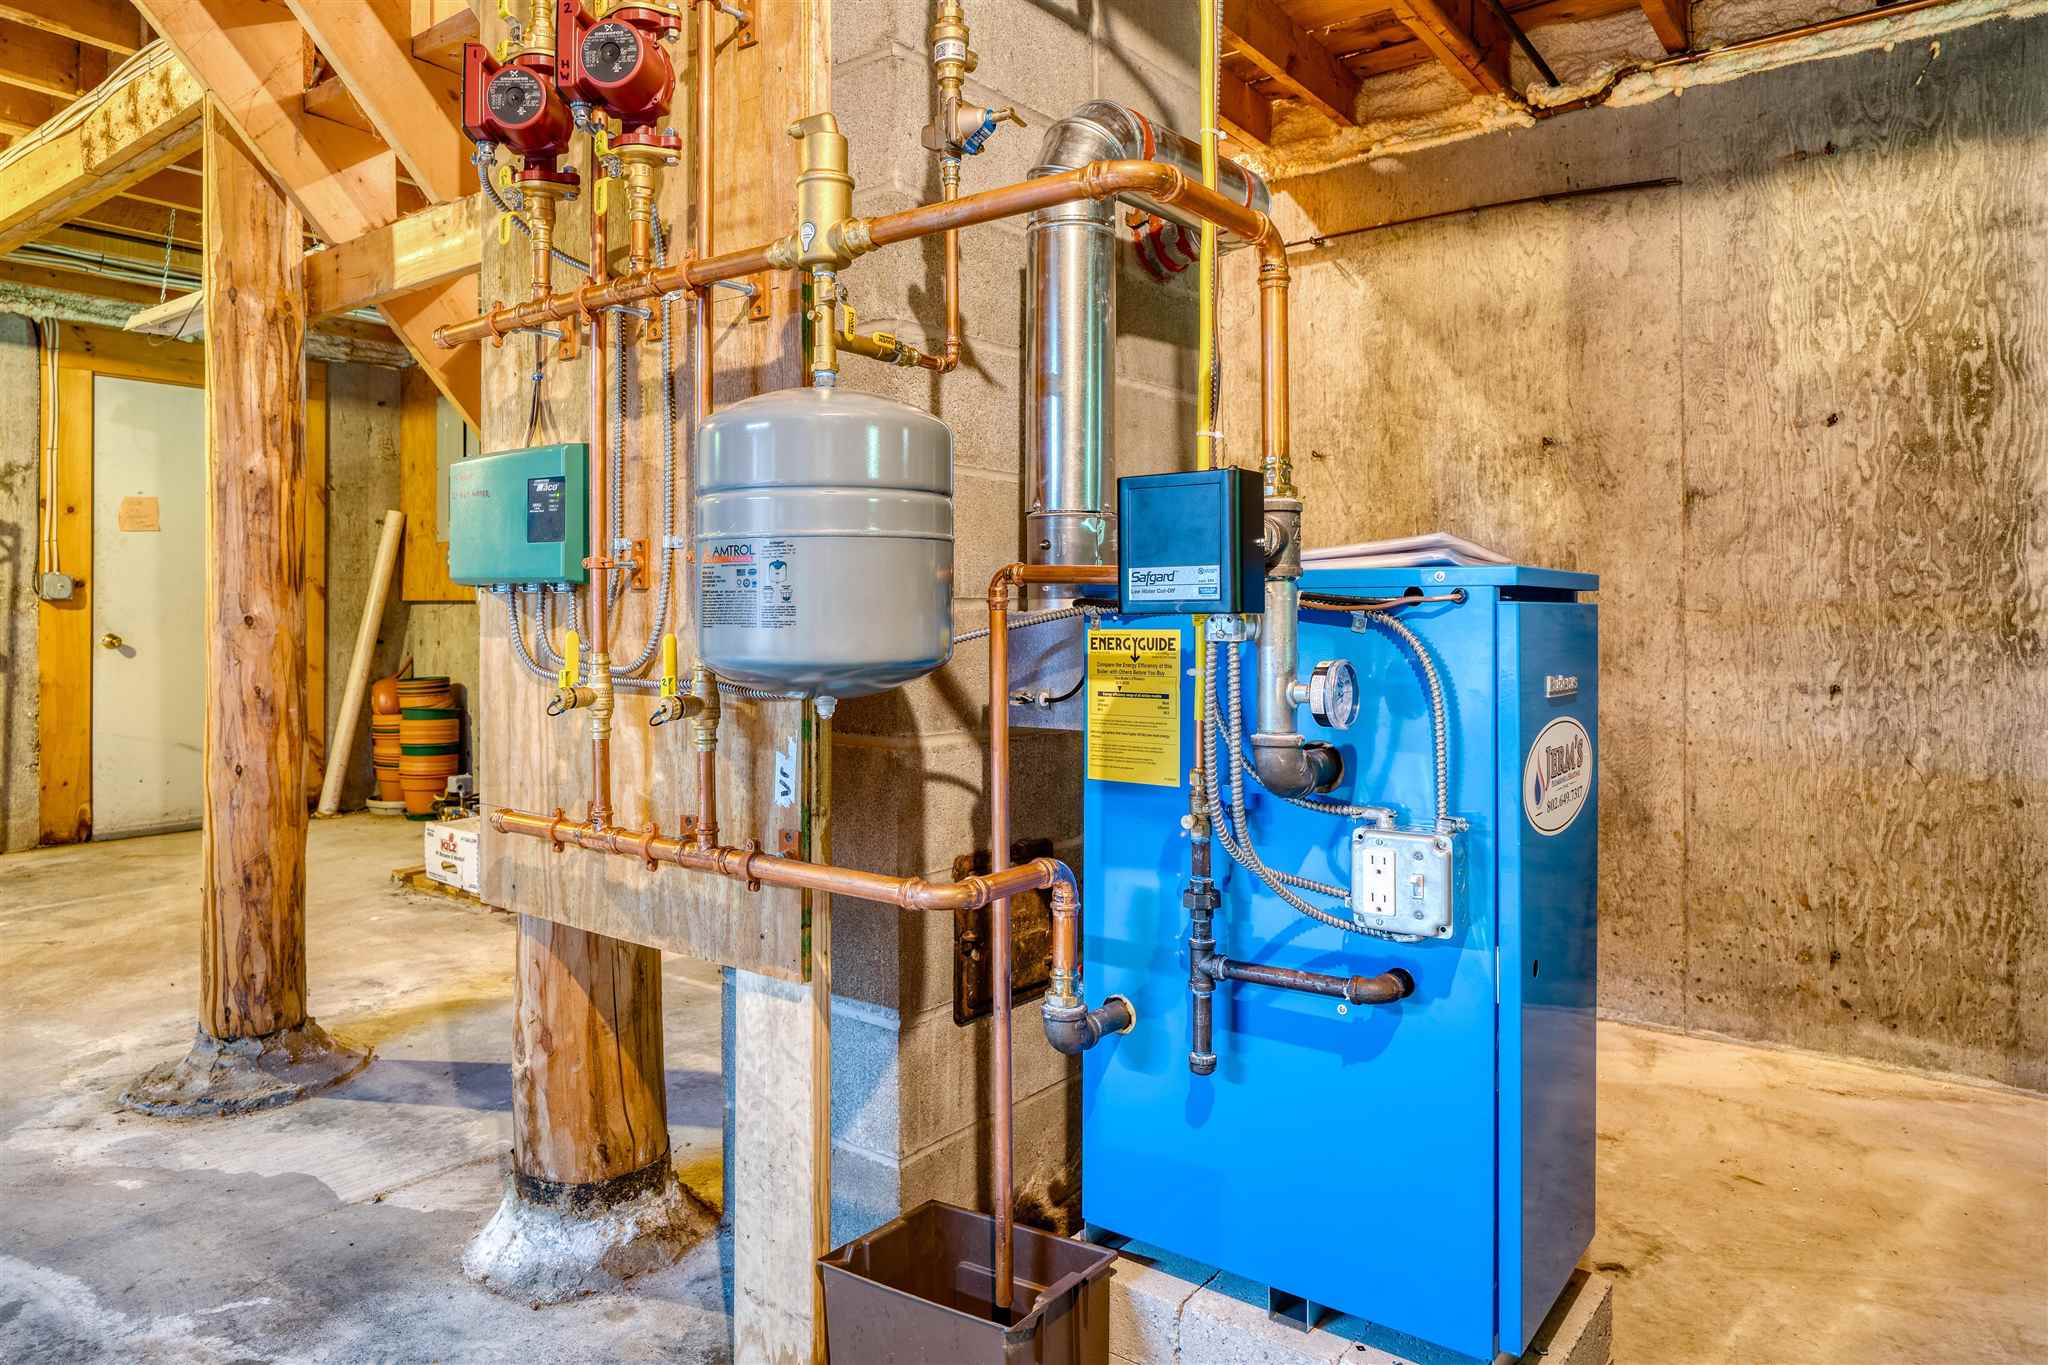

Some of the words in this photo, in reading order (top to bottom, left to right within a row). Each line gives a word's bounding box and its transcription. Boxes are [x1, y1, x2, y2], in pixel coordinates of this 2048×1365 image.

[563, 3, 573, 14] 2
[713, 544, 755, 557] AMTROL
[1131, 570, 1175, 586] Safgard
[1090, 637, 1176, 651] ENERGYGUIDE
[1545, 735, 1583, 787] JERM'S
